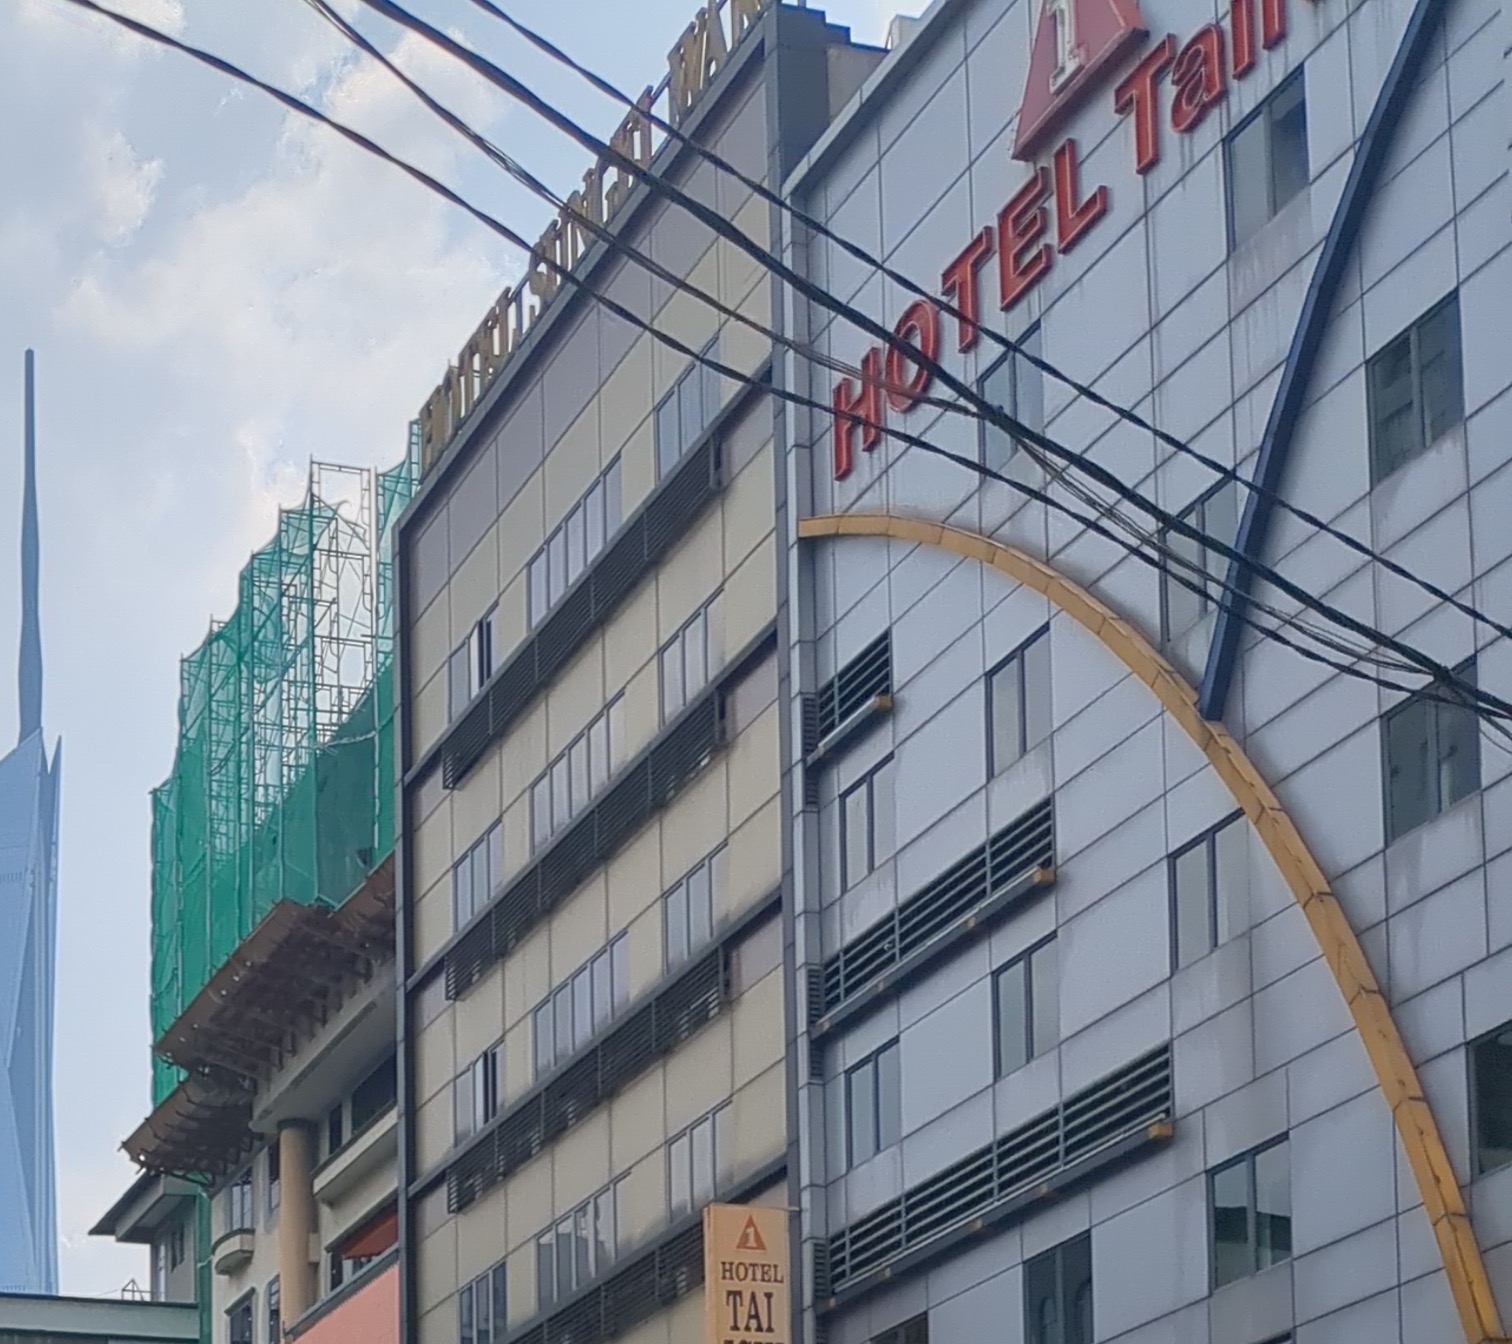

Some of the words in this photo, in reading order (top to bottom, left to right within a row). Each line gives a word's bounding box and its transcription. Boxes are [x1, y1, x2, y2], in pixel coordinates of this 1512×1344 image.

[833, 138, 1108, 482] HOTEL
[721, 1261, 785, 1284] HOTEL
[726, 1290, 775, 1333] TAI
